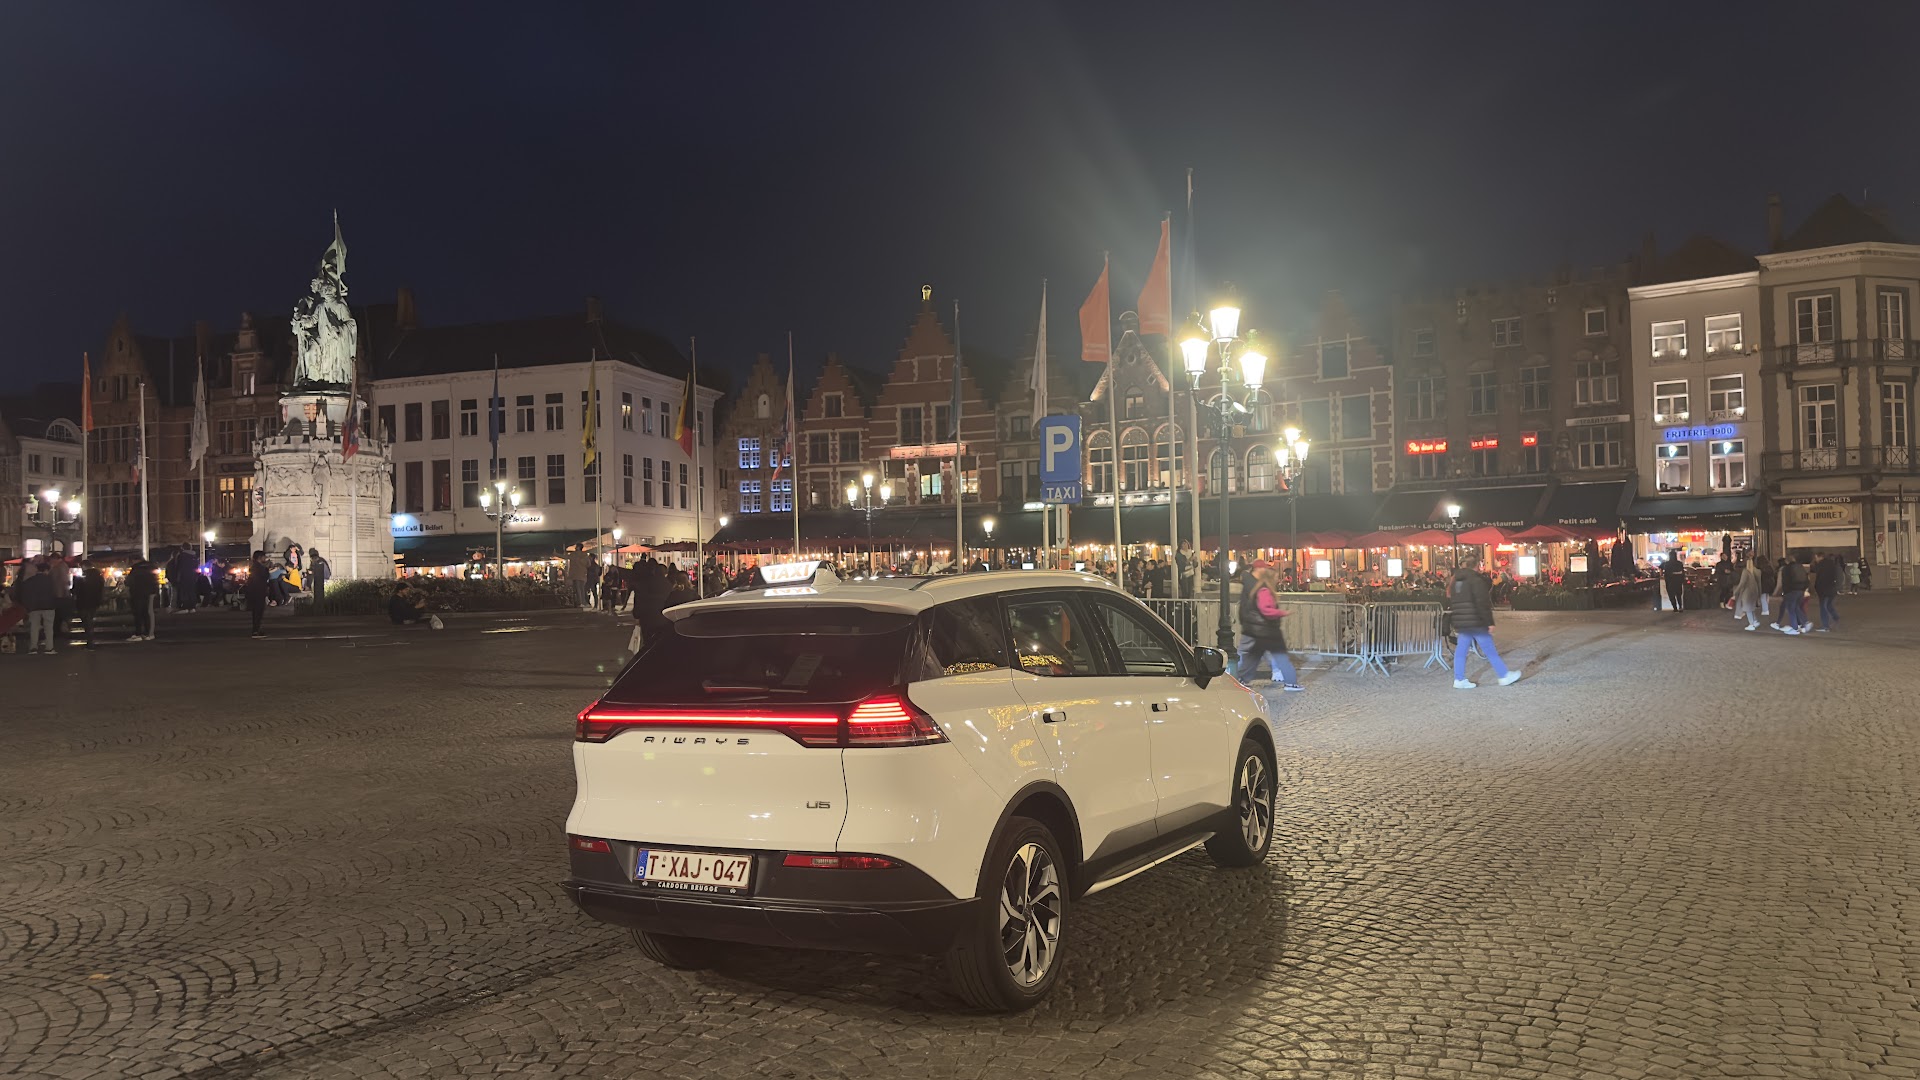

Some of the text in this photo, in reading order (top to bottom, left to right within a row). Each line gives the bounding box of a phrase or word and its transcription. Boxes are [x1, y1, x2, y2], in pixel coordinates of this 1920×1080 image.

[1666, 427, 1732, 438] FRITERIE 1900
[1046, 425, 1074, 472] P
[1046, 486, 1076, 500] TAXI
[1579, 517, 1597, 525] café
[406, 524, 418, 532] Café
[769, 564, 810, 580] TAXI
[643, 736, 750, 746] AIWAYS
[806, 800, 831, 809] U5
[637, 866, 644, 876] B
[657, 881, 689, 890] CARDOEN
